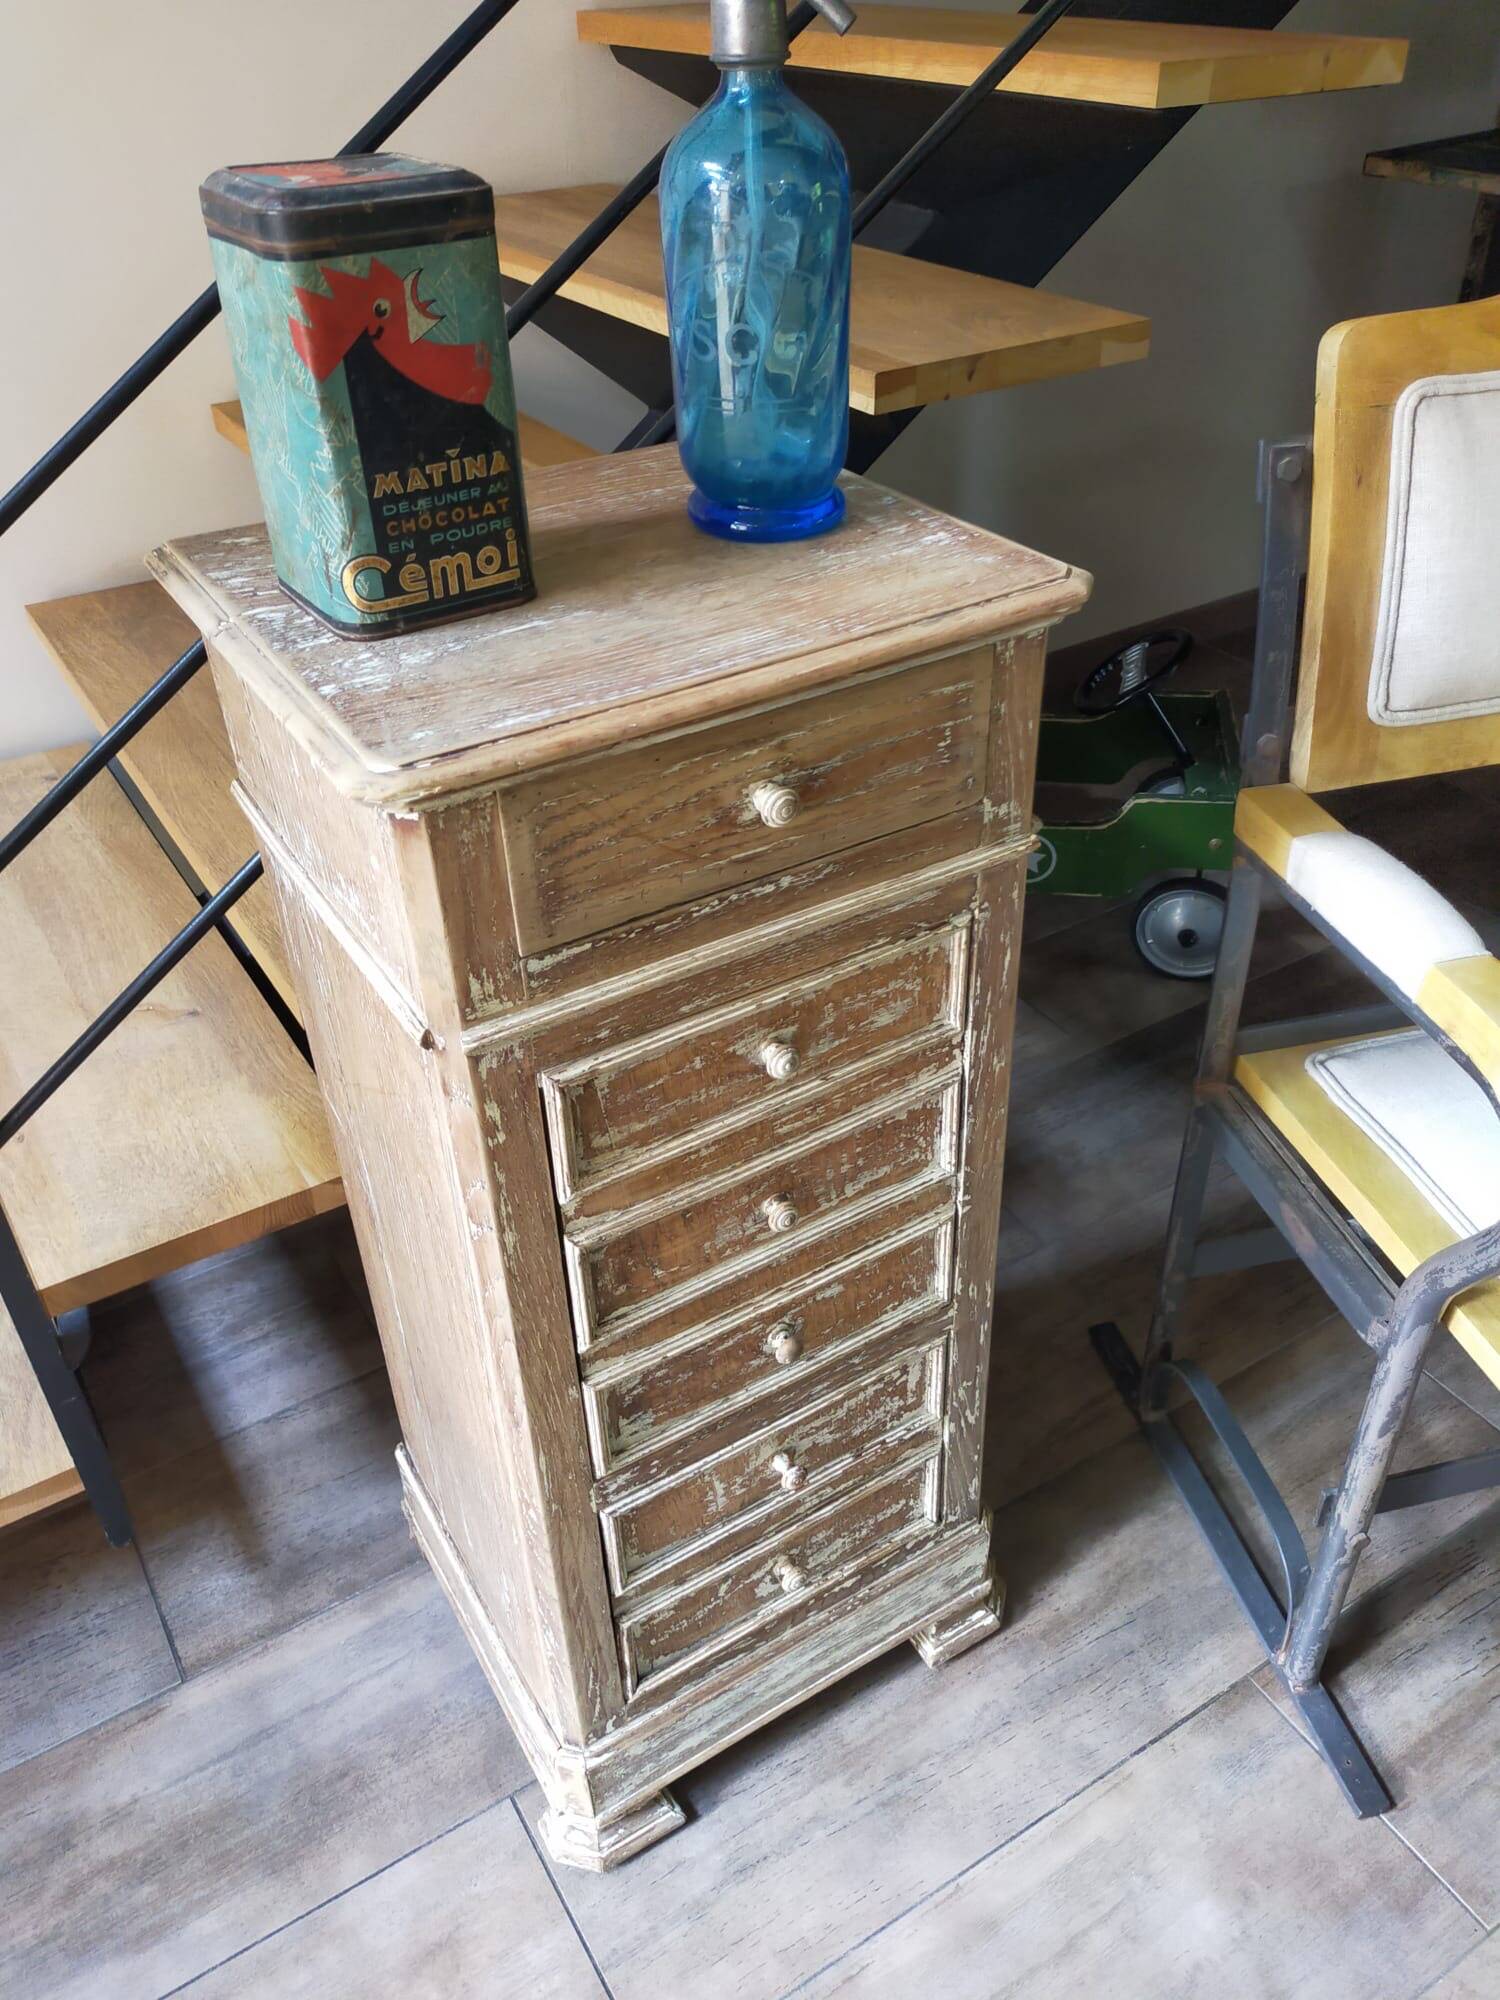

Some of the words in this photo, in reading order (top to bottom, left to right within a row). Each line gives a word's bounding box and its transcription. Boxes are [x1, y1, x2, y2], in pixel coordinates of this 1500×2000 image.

[373, 448, 512, 499] MATINA
[386, 497, 511, 537] CHOCOLAT
[388, 538, 415, 554] EN
[430, 516, 513, 546] POUDRE
[342, 527, 521, 614] Cémoi
